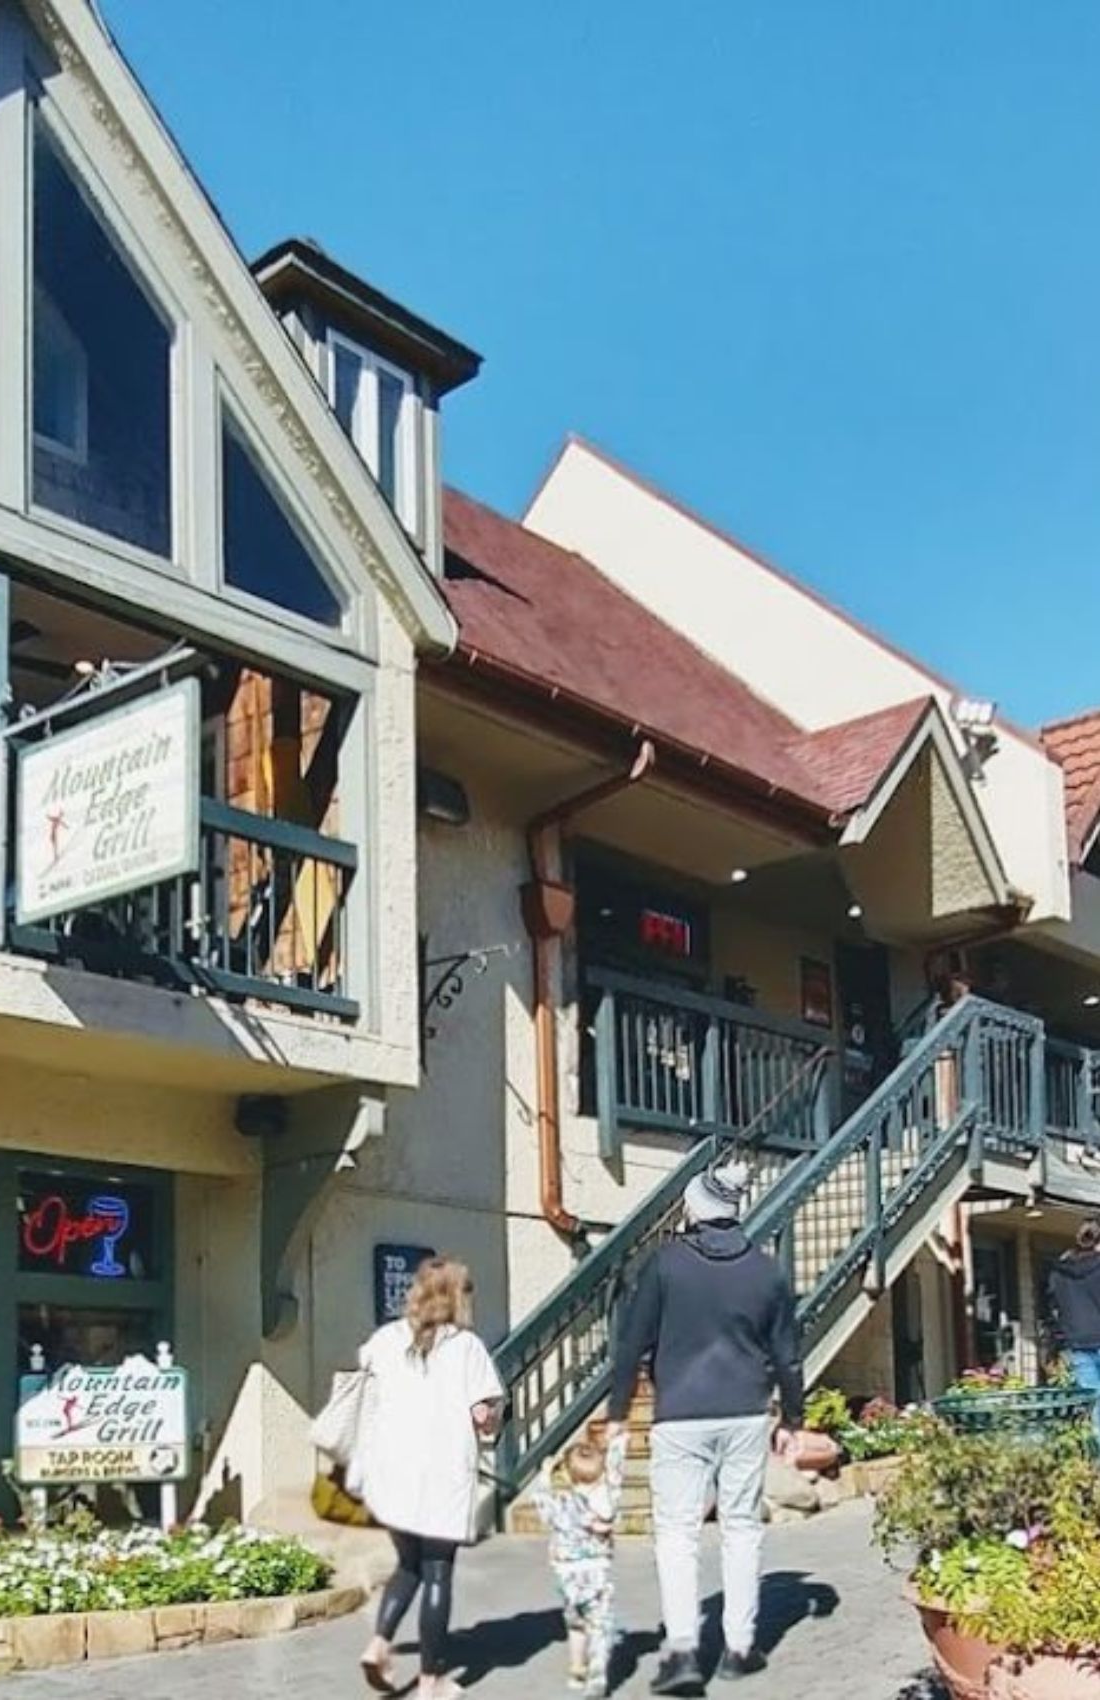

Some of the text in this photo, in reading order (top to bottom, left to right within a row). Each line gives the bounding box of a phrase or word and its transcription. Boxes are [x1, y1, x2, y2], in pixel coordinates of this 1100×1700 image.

[43, 731, 172, 806] Mountain
[85, 780, 149, 826] Edge
[93, 806, 156, 861] Grill
[24, 1196, 116, 1264] Open
[86, 1394, 157, 1422] Edge
[97, 1418, 163, 1442] Grill
[49, 1450, 133, 1465] TAP ROOM
